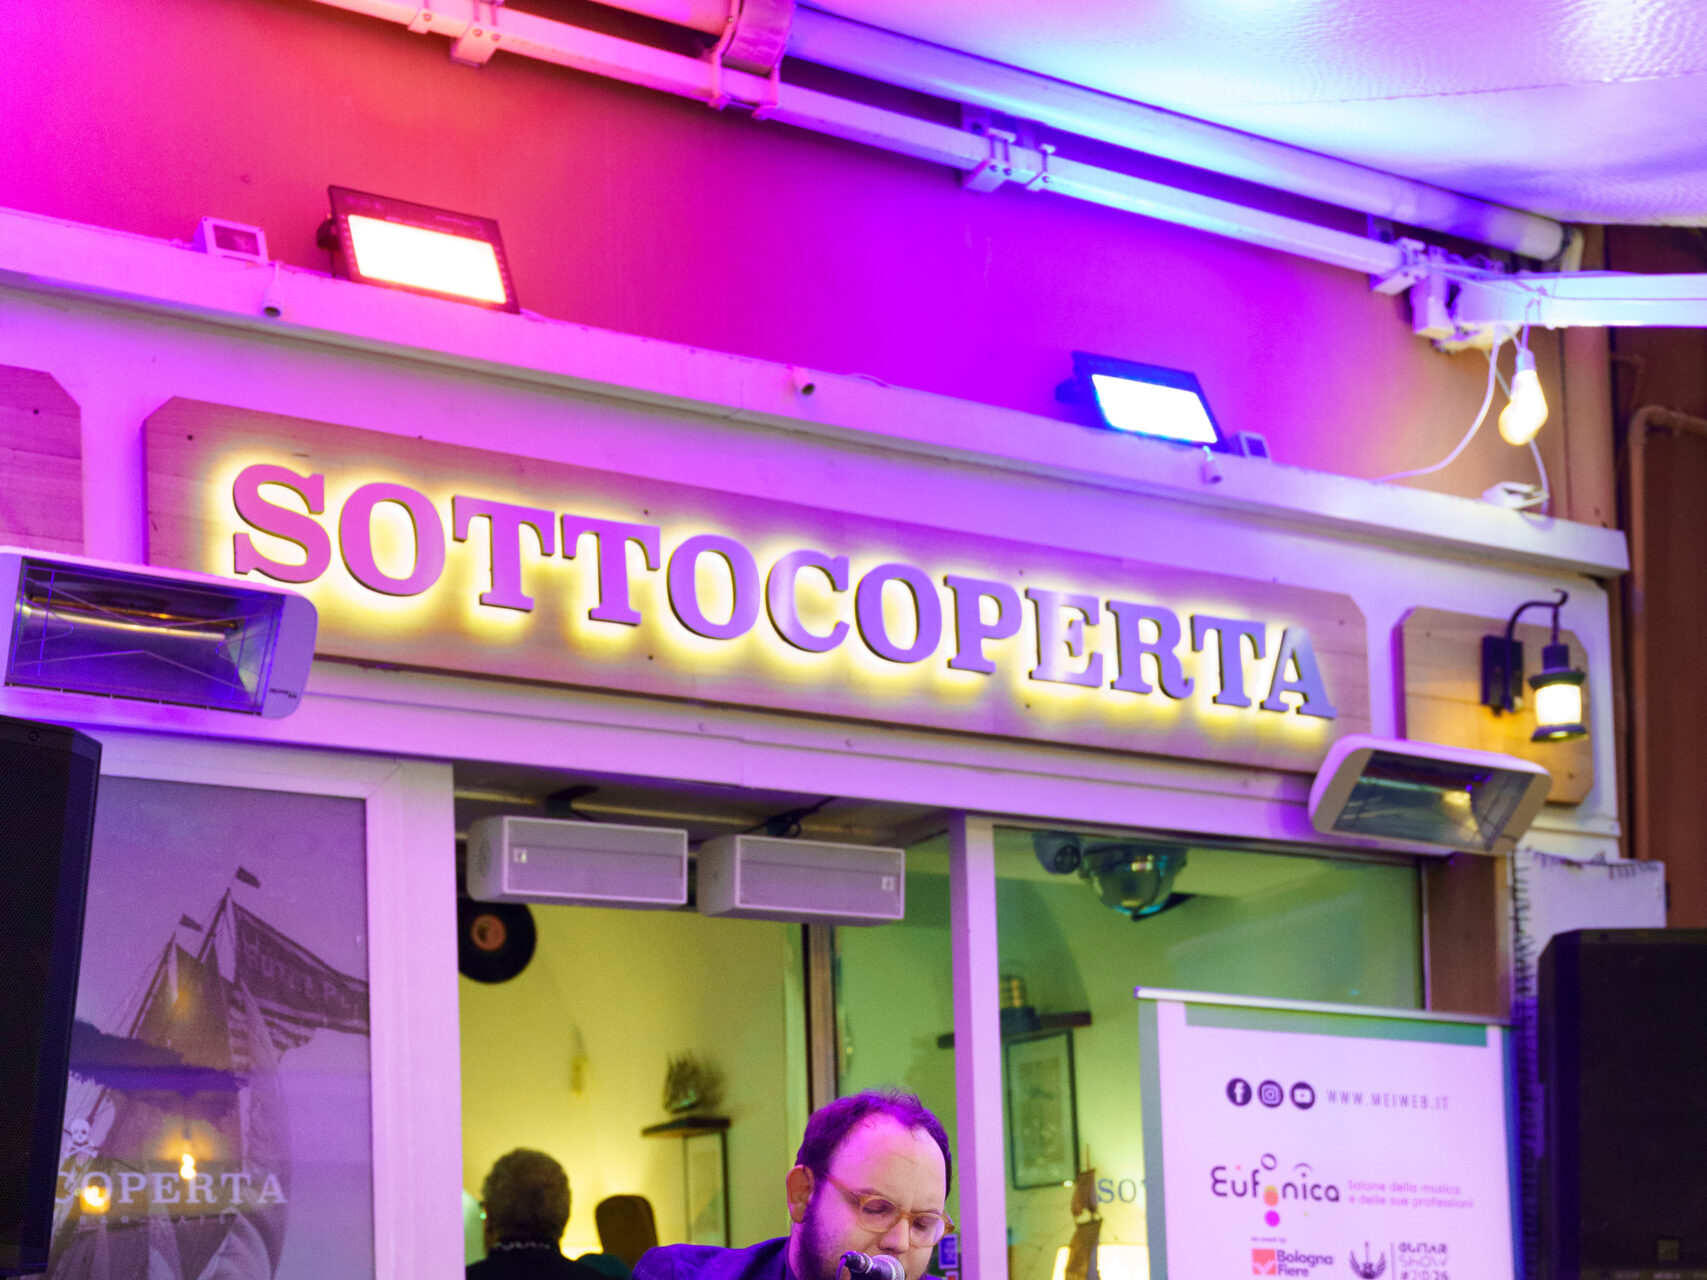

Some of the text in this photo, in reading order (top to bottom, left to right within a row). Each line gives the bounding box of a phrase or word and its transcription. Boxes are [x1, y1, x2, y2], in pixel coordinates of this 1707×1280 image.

[232, 463, 1337, 719] SOTTOCOPERTA
[1326, 1089, 1450, 1111] WWW.MEIWEB.IT
[1389, 1181, 1417, 1193] della
[1276, 1249, 1334, 1268] Bologna
[1276, 1264, 1310, 1278] Fiere
